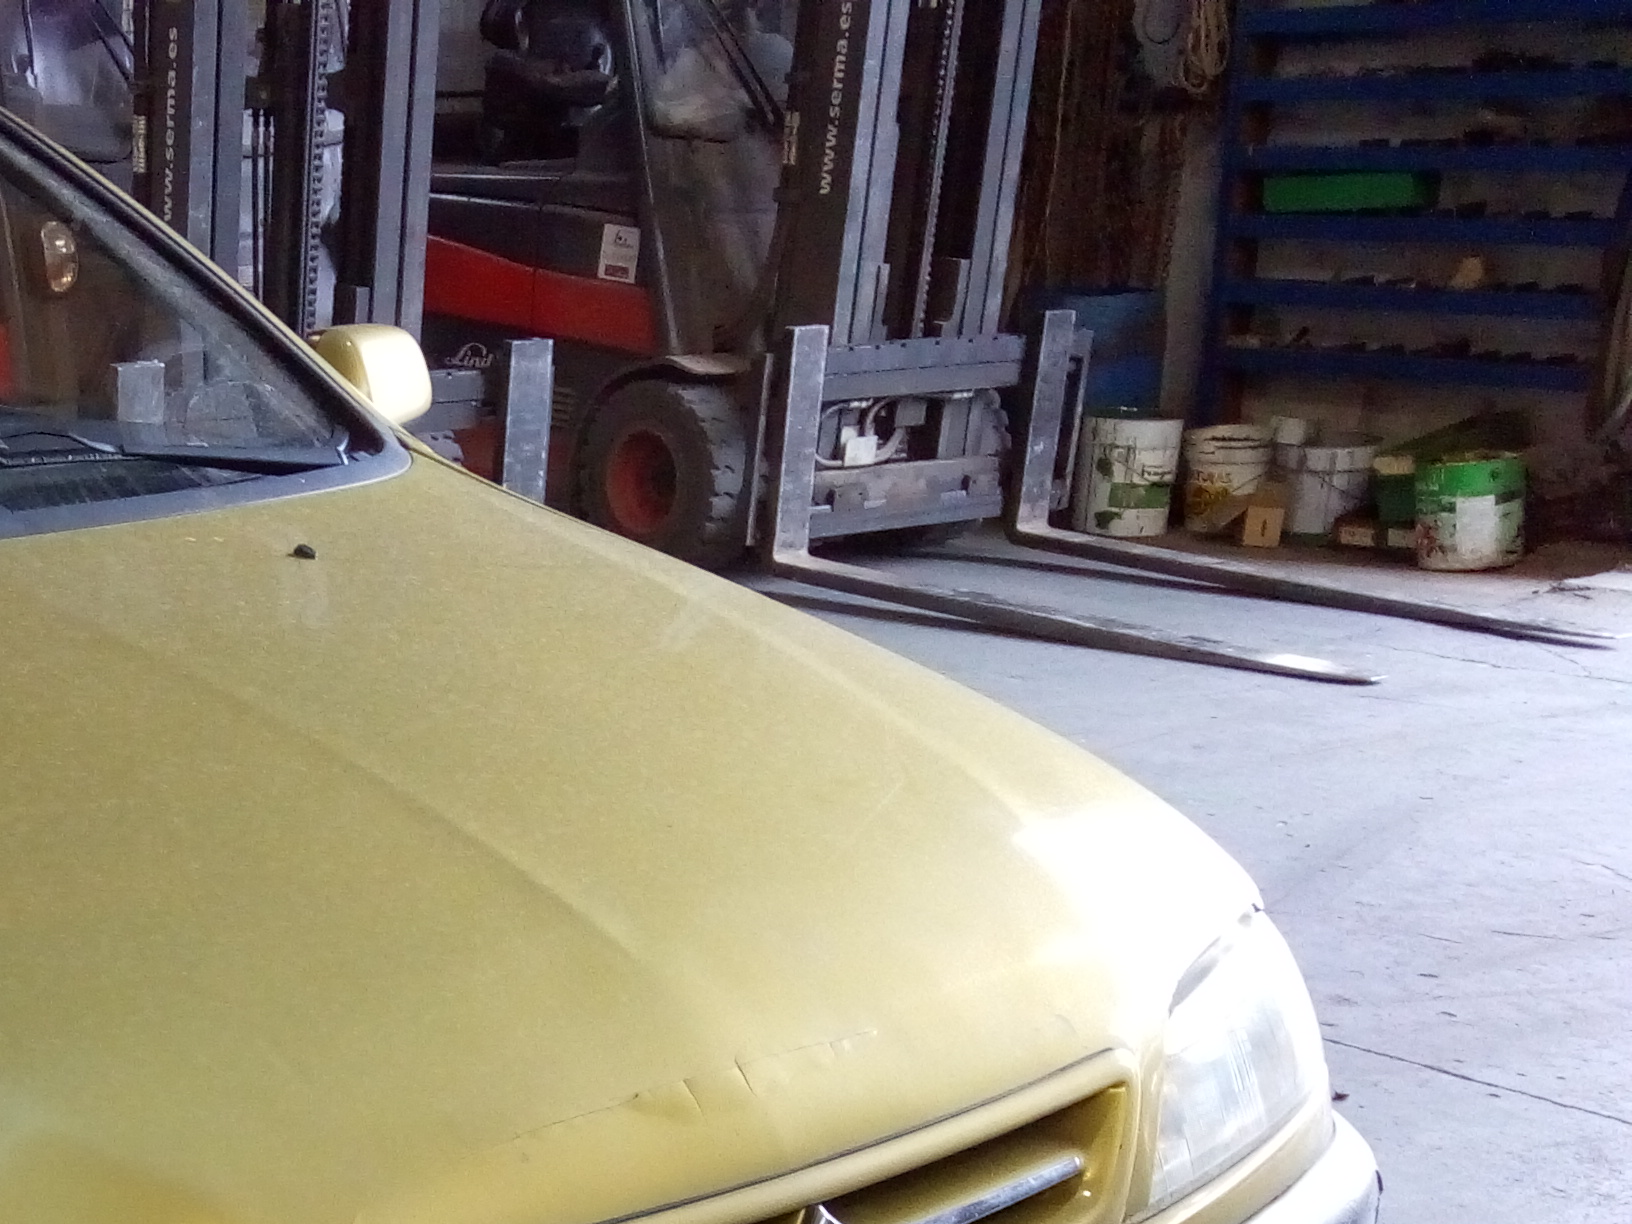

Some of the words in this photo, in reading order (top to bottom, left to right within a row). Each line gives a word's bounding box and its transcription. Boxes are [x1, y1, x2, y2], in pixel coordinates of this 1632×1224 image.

[164, 27, 178, 222] ww.serma.es
[819, 1, 853, 194] www.serma.es
[445, 342, 495, 368] Lind
